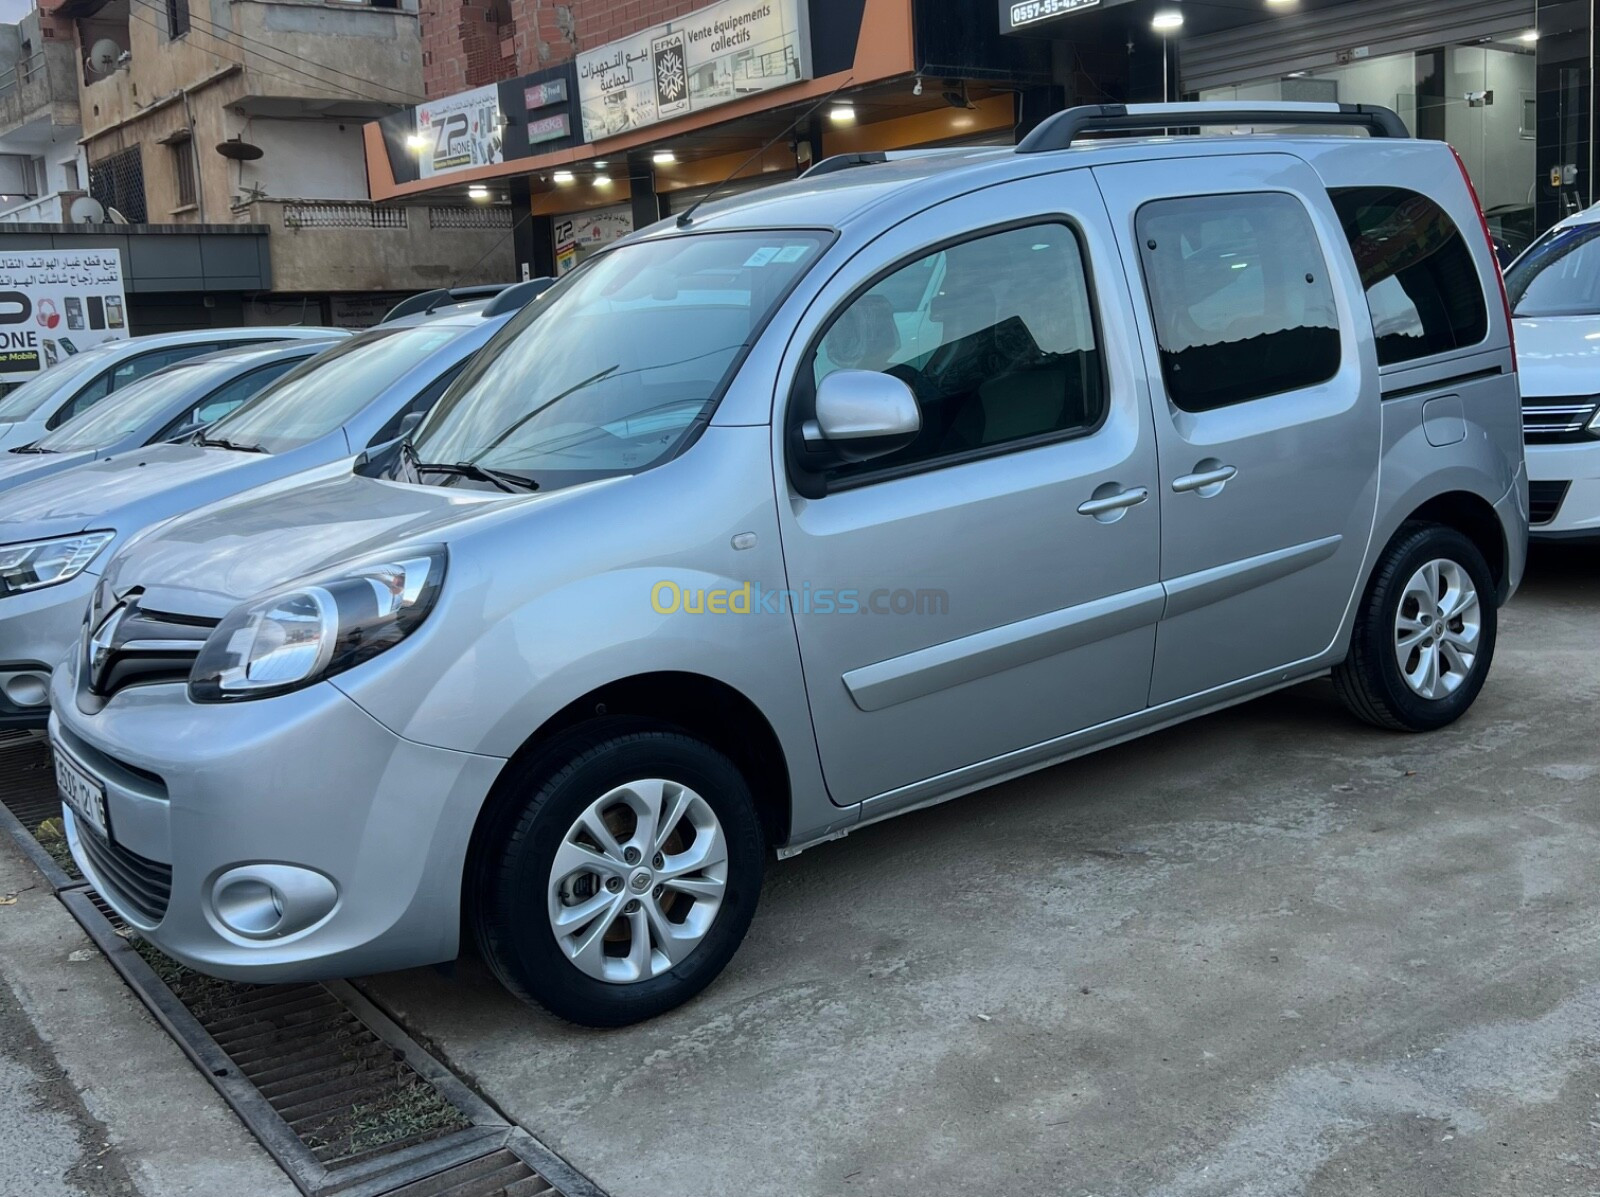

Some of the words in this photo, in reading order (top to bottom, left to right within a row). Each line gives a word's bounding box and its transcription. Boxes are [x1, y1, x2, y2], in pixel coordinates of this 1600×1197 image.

[1013, 0, 1096, 22] 0557-55-4-
[688, 26, 712, 43] Vente
[714, 4, 771, 34] équipements
[654, 37, 681, 51] EFKA
[711, 28, 751, 53] collectifs
[626, 47, 648, 66] بيع
[581, 51, 624, 79] التجهيزات
[600, 66, 634, 92] الجماعية
[61, 256, 81, 270] غيار
[83, 255, 101, 271] قطع
[103, 258, 116, 270] بيع
[39, 273, 69, 284] شاشات
[70, 273, 93, 287] زجاج
[96, 271, 118, 285] تغيير
[0, 331, 38, 349] ONE
[9, 353, 37, 361] Mobile
